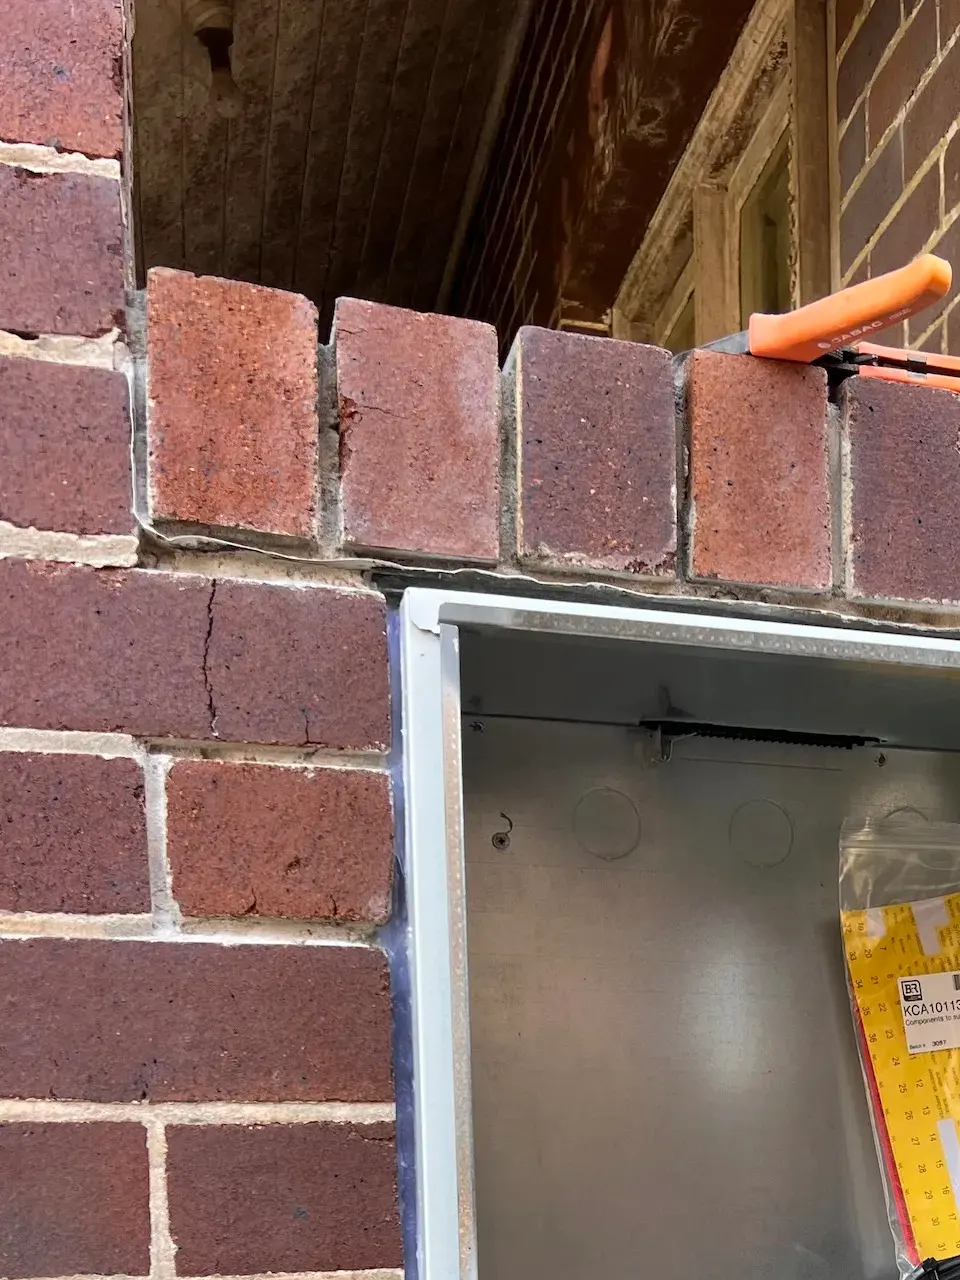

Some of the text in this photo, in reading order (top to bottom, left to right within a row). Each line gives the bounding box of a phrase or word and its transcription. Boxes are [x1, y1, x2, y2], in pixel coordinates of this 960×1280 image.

[850, 952, 857, 960] 33
[864, 948, 872, 958] 20
[856, 980, 863, 988] 34
[871, 976, 878, 984] 21
[862, 1006, 870, 1016] 35
[879, 1003, 887, 1012] 22
[906, 1017, 944, 1026] Components
[868, 1033, 877, 1043] 36
[886, 1029, 894, 1039] 23
[892, 1056, 900, 1066] 24
[916, 1078, 924, 1088] 12
[898, 1084, 907, 1094] 25
[904, 1110, 914, 1120] 26
[922, 1106, 930, 1116] 13
[911, 1136, 920, 1146] 27
[930, 1132, 936, 1142] 14
[918, 1164, 926, 1174] 28
[936, 1160, 944, 1168] 15
[924, 1190, 933, 1200] 29
[942, 1186, 950, 1194] 16
[932, 1217, 940, 1226] 30
[938, 1243, 947, 1251] 31
